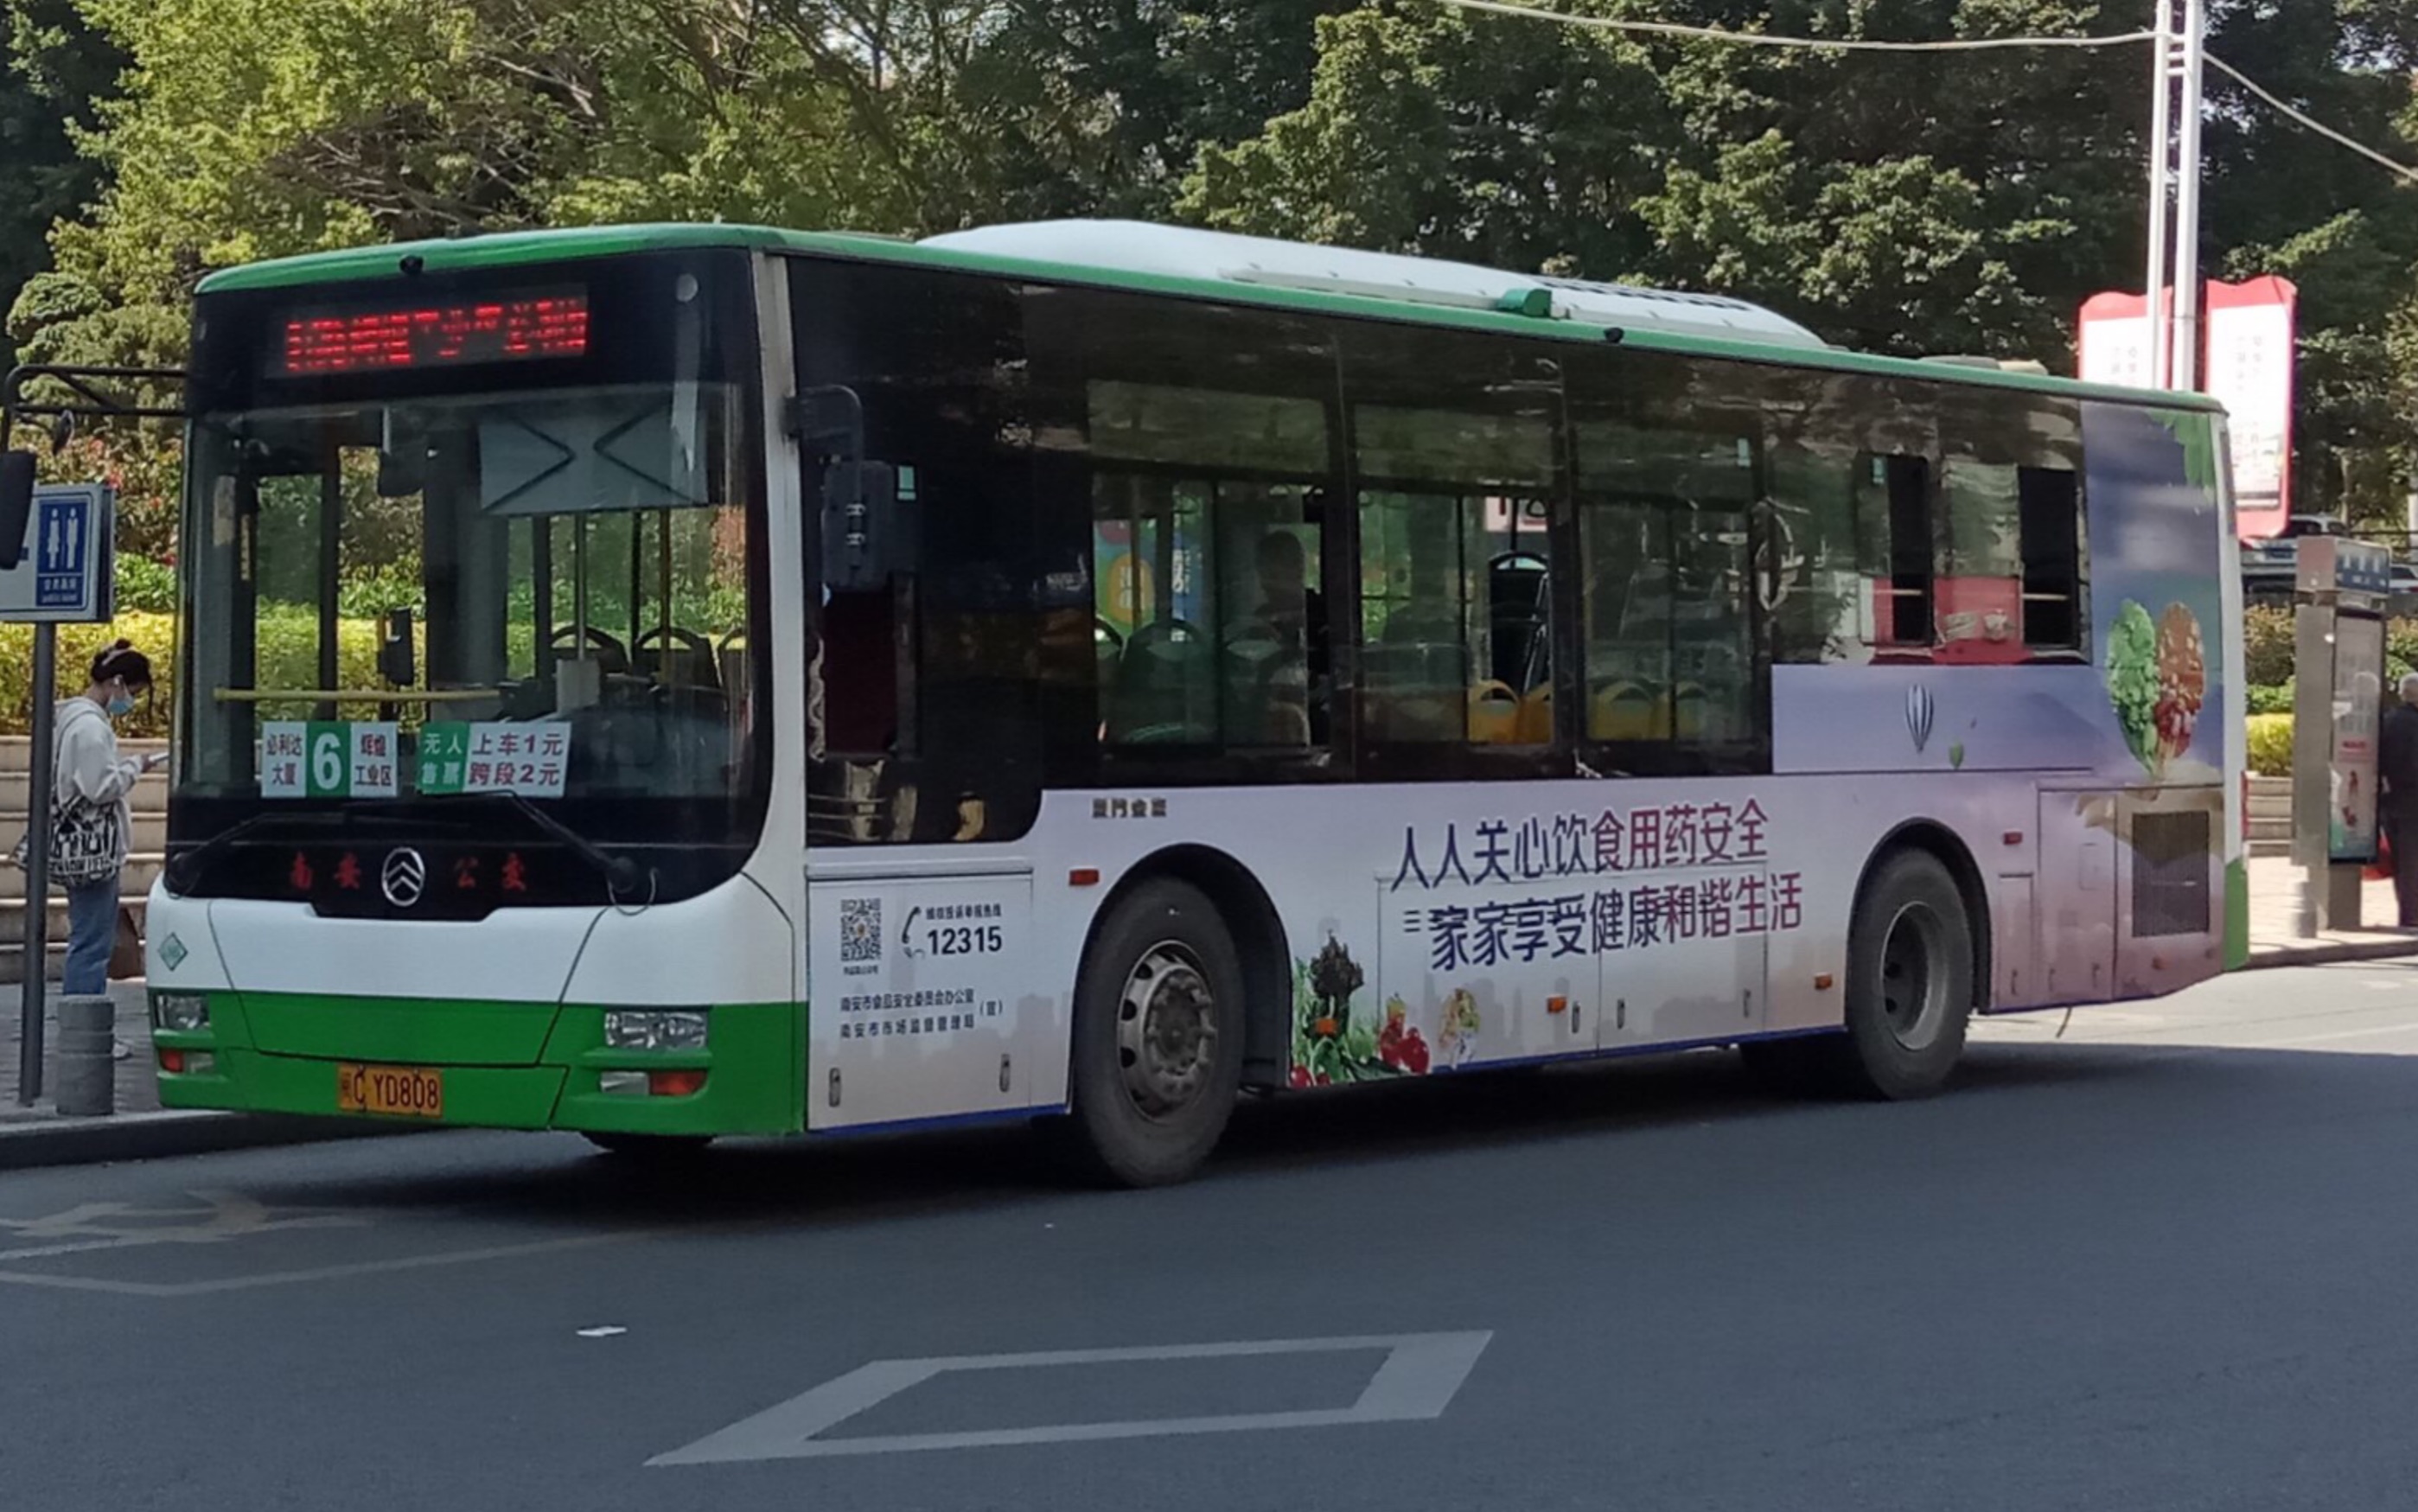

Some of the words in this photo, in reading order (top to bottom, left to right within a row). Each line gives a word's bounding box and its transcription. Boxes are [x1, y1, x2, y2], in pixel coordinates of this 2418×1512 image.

[424, 733, 462, 756] 无人
[471, 732, 563, 756] 上车1元
[313, 732, 342, 790] 6
[468, 761, 561, 786] 跨段2元
[354, 763, 392, 787] 工业区
[1390, 797, 1769, 892] 人人关心饮食用药安全
[1427, 871, 1802, 971] 家家享受健康和谐生活
[928, 925, 1002, 955] 12315
